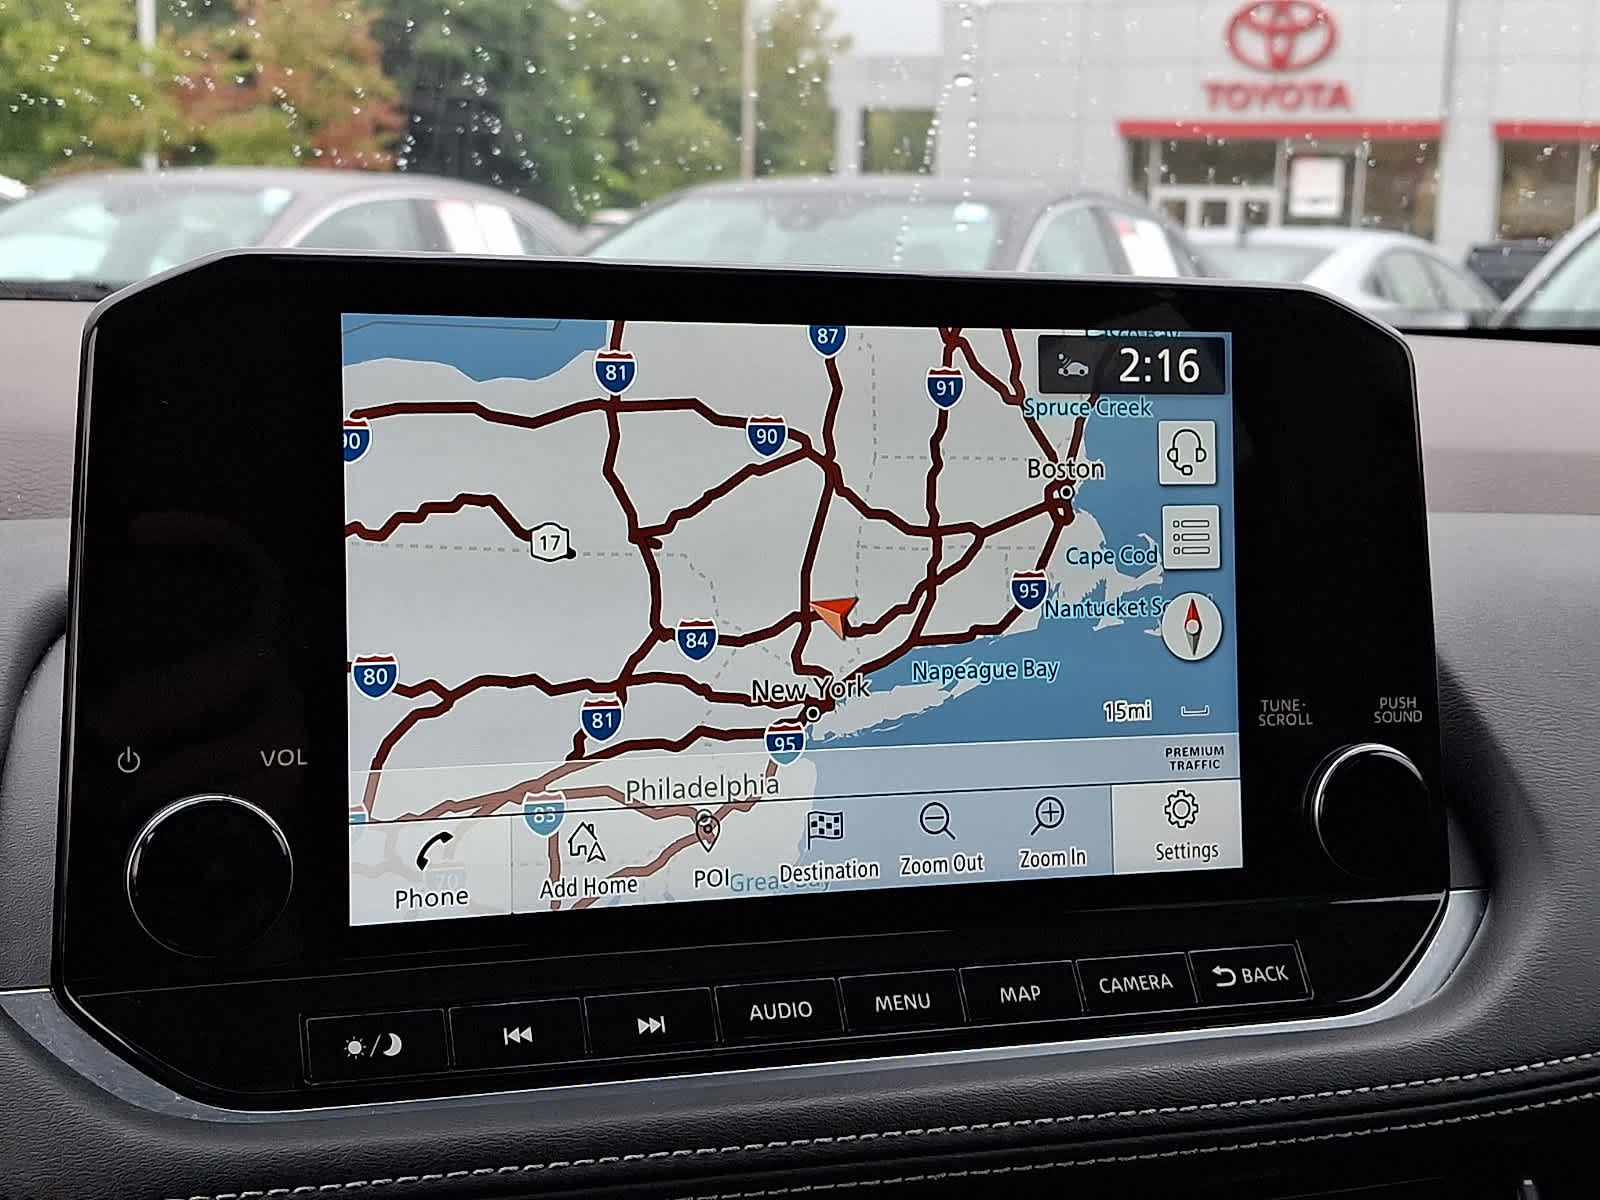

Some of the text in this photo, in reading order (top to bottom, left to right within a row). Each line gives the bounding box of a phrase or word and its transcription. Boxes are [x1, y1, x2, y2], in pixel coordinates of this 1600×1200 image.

[1203, 81, 1353, 111] TOYOTA
[817, 328, 838, 345] 87
[604, 364, 626, 382] 81
[1119, 347, 1200, 383] 2:16
[936, 380, 956, 397] 91
[1024, 397, 1153, 418] Spruce Creek
[756, 428, 778, 445] 90
[1028, 459, 1105, 480] Boston
[539, 534, 561, 552] 17
[1066, 546, 1158, 569] Cape Cod
[1019, 584, 1039, 599] 95
[1045, 597, 1147, 618] Nantucket
[685, 632, 708, 649] 84
[362, 668, 389, 685] 80
[912, 659, 1060, 683] Napeague Bay
[752, 674, 870, 701] New York
[1104, 701, 1152, 720] 15mi
[1380, 696, 1417, 709] PUSH
[591, 712, 613, 729] 81
[1258, 712, 1313, 726] SCROLL
[1374, 709, 1423, 723] SOUND
[774, 736, 796, 751] 95
[1165, 745, 1225, 758] PREMIUM
[260, 749, 308, 767] VOL
[1170, 758, 1220, 771] TRAFFIC
[626, 774, 779, 801] Philadelphia
[533, 806, 556, 824] 83
[1020, 849, 1086, 869] Zoom In
[1156, 843, 1219, 864] Settings
[781, 861, 879, 882] Destination
[900, 854, 984, 875] Zoom Out
[540, 877, 638, 898] Add Home
[694, 868, 729, 888] POI
[396, 888, 469, 909] Phone
[1099, 973, 1174, 995] CAMERA
[1242, 964, 1289, 984] BACK
[875, 992, 931, 1012] MENU
[1000, 985, 1041, 1004] MAP
[749, 1001, 813, 1022] AUDIO
